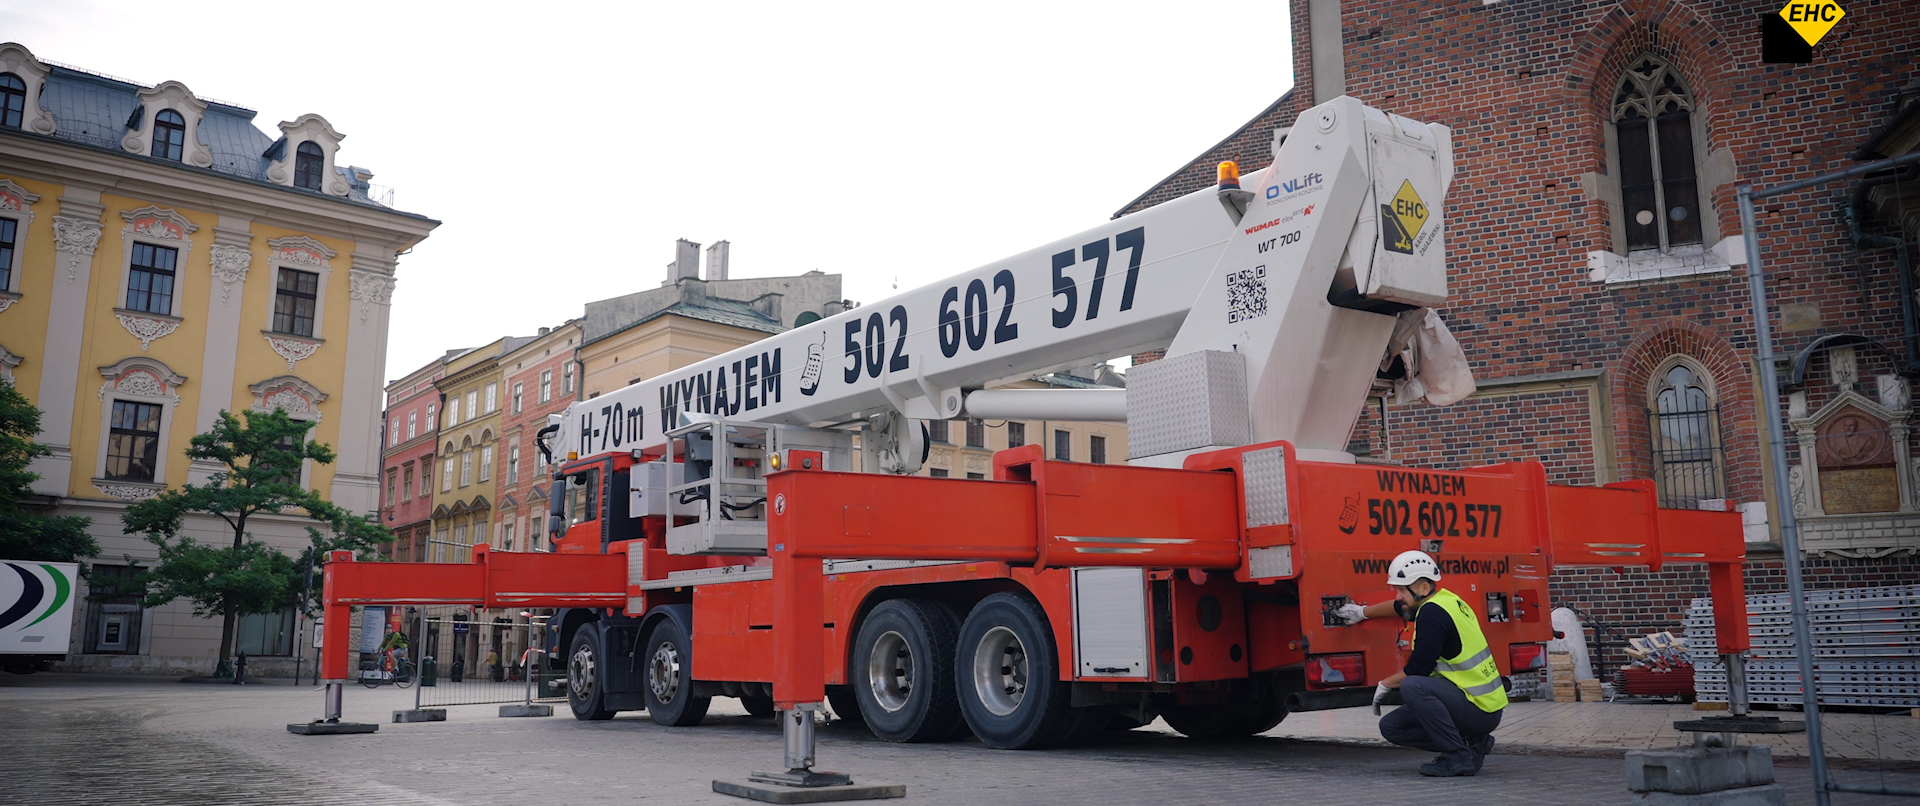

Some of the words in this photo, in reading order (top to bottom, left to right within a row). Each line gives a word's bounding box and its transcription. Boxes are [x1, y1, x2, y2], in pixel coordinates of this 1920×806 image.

[1396, 198, 1424, 220] EHC
[1245, 218, 1281, 235] WUMAG
[1258, 238, 1277, 254] WT
[1280, 230, 1301, 247] 700
[1414, 230, 1428, 249] KAROL
[1419, 223, 1441, 257] ZAGAJEWSKI
[659, 347, 781, 435] WYNAJEM
[844, 304, 909, 384] 502
[938, 269, 1018, 359] 602
[1051, 226, 1145, 329] 577
[1376, 470, 1466, 497] WYNAJEM
[1368, 498, 1413, 536] 502
[1418, 500, 1460, 537] 602
[1464, 503, 1502, 538] 577
